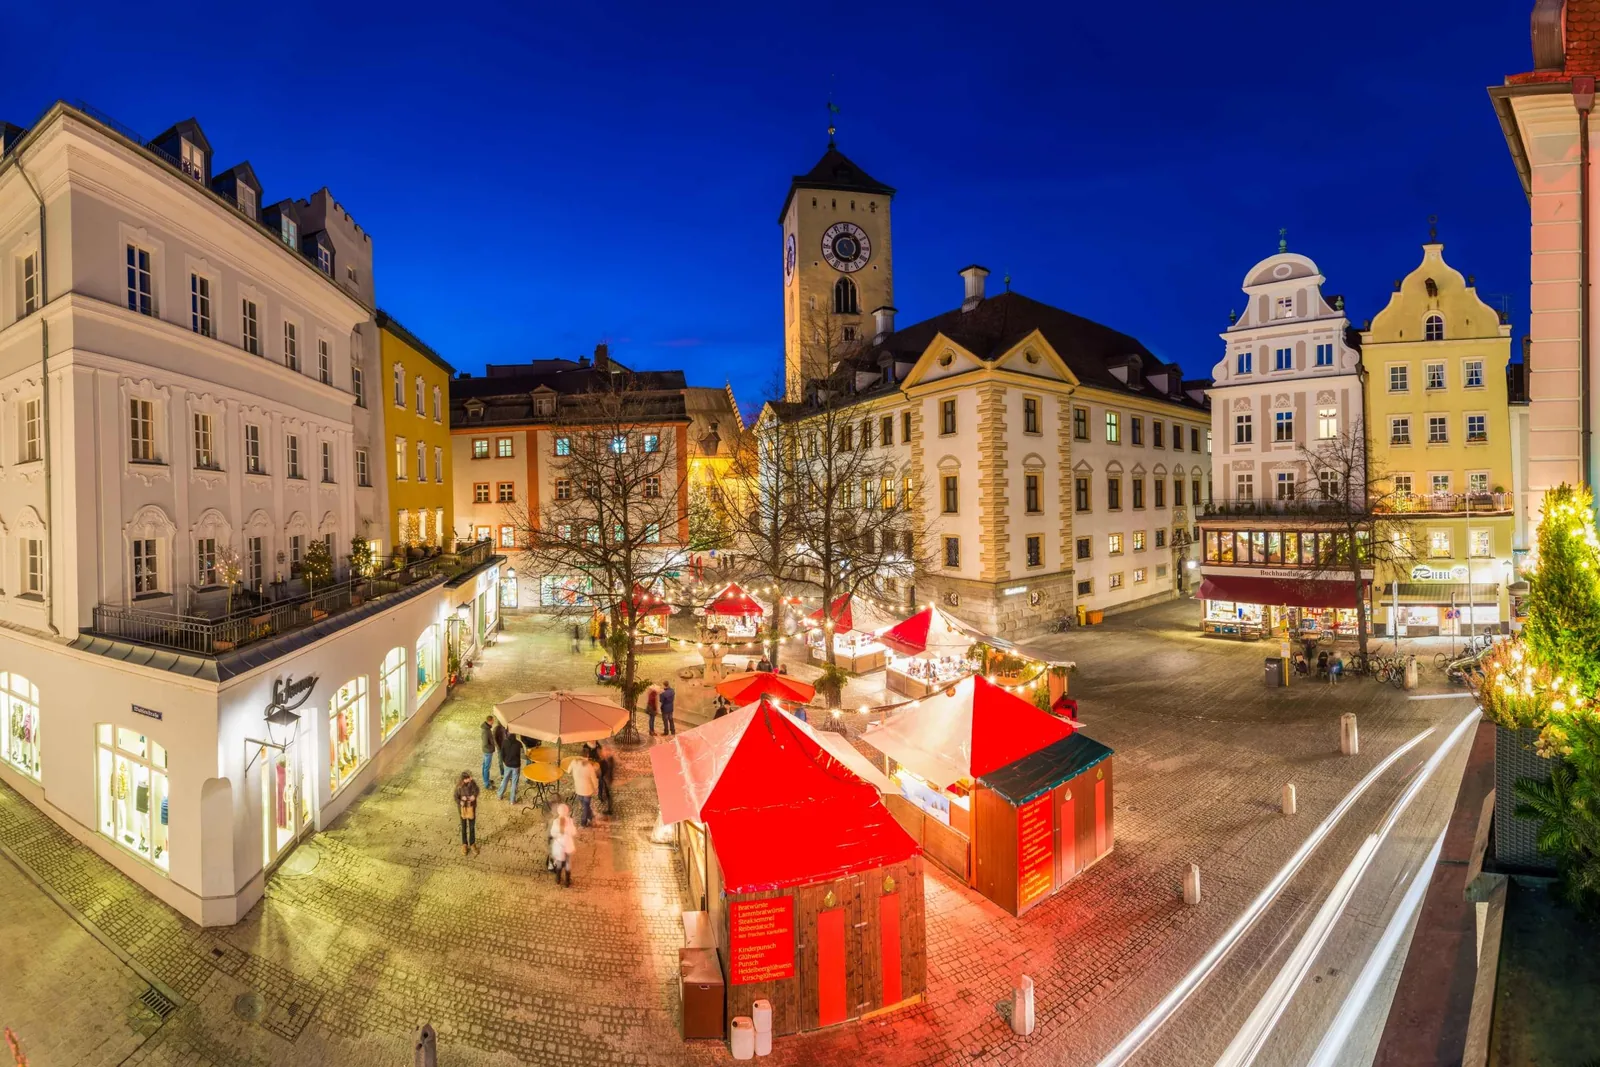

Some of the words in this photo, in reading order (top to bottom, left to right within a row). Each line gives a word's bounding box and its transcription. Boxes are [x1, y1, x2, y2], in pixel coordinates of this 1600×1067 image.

[738, 903, 769, 911] Bratwürste
[738, 908, 786, 918] Lammbratwürste
[738, 915, 775, 925] Steaksemmel
[738, 922, 775, 932] Reiberdatschi
[738, 943, 777, 953] Kinderpunsch
[738, 952, 765, 961] Glühwein
[738, 963, 793, 975] Heidelbeerglühwein
[742, 971, 786, 982] Kirschglühwein
